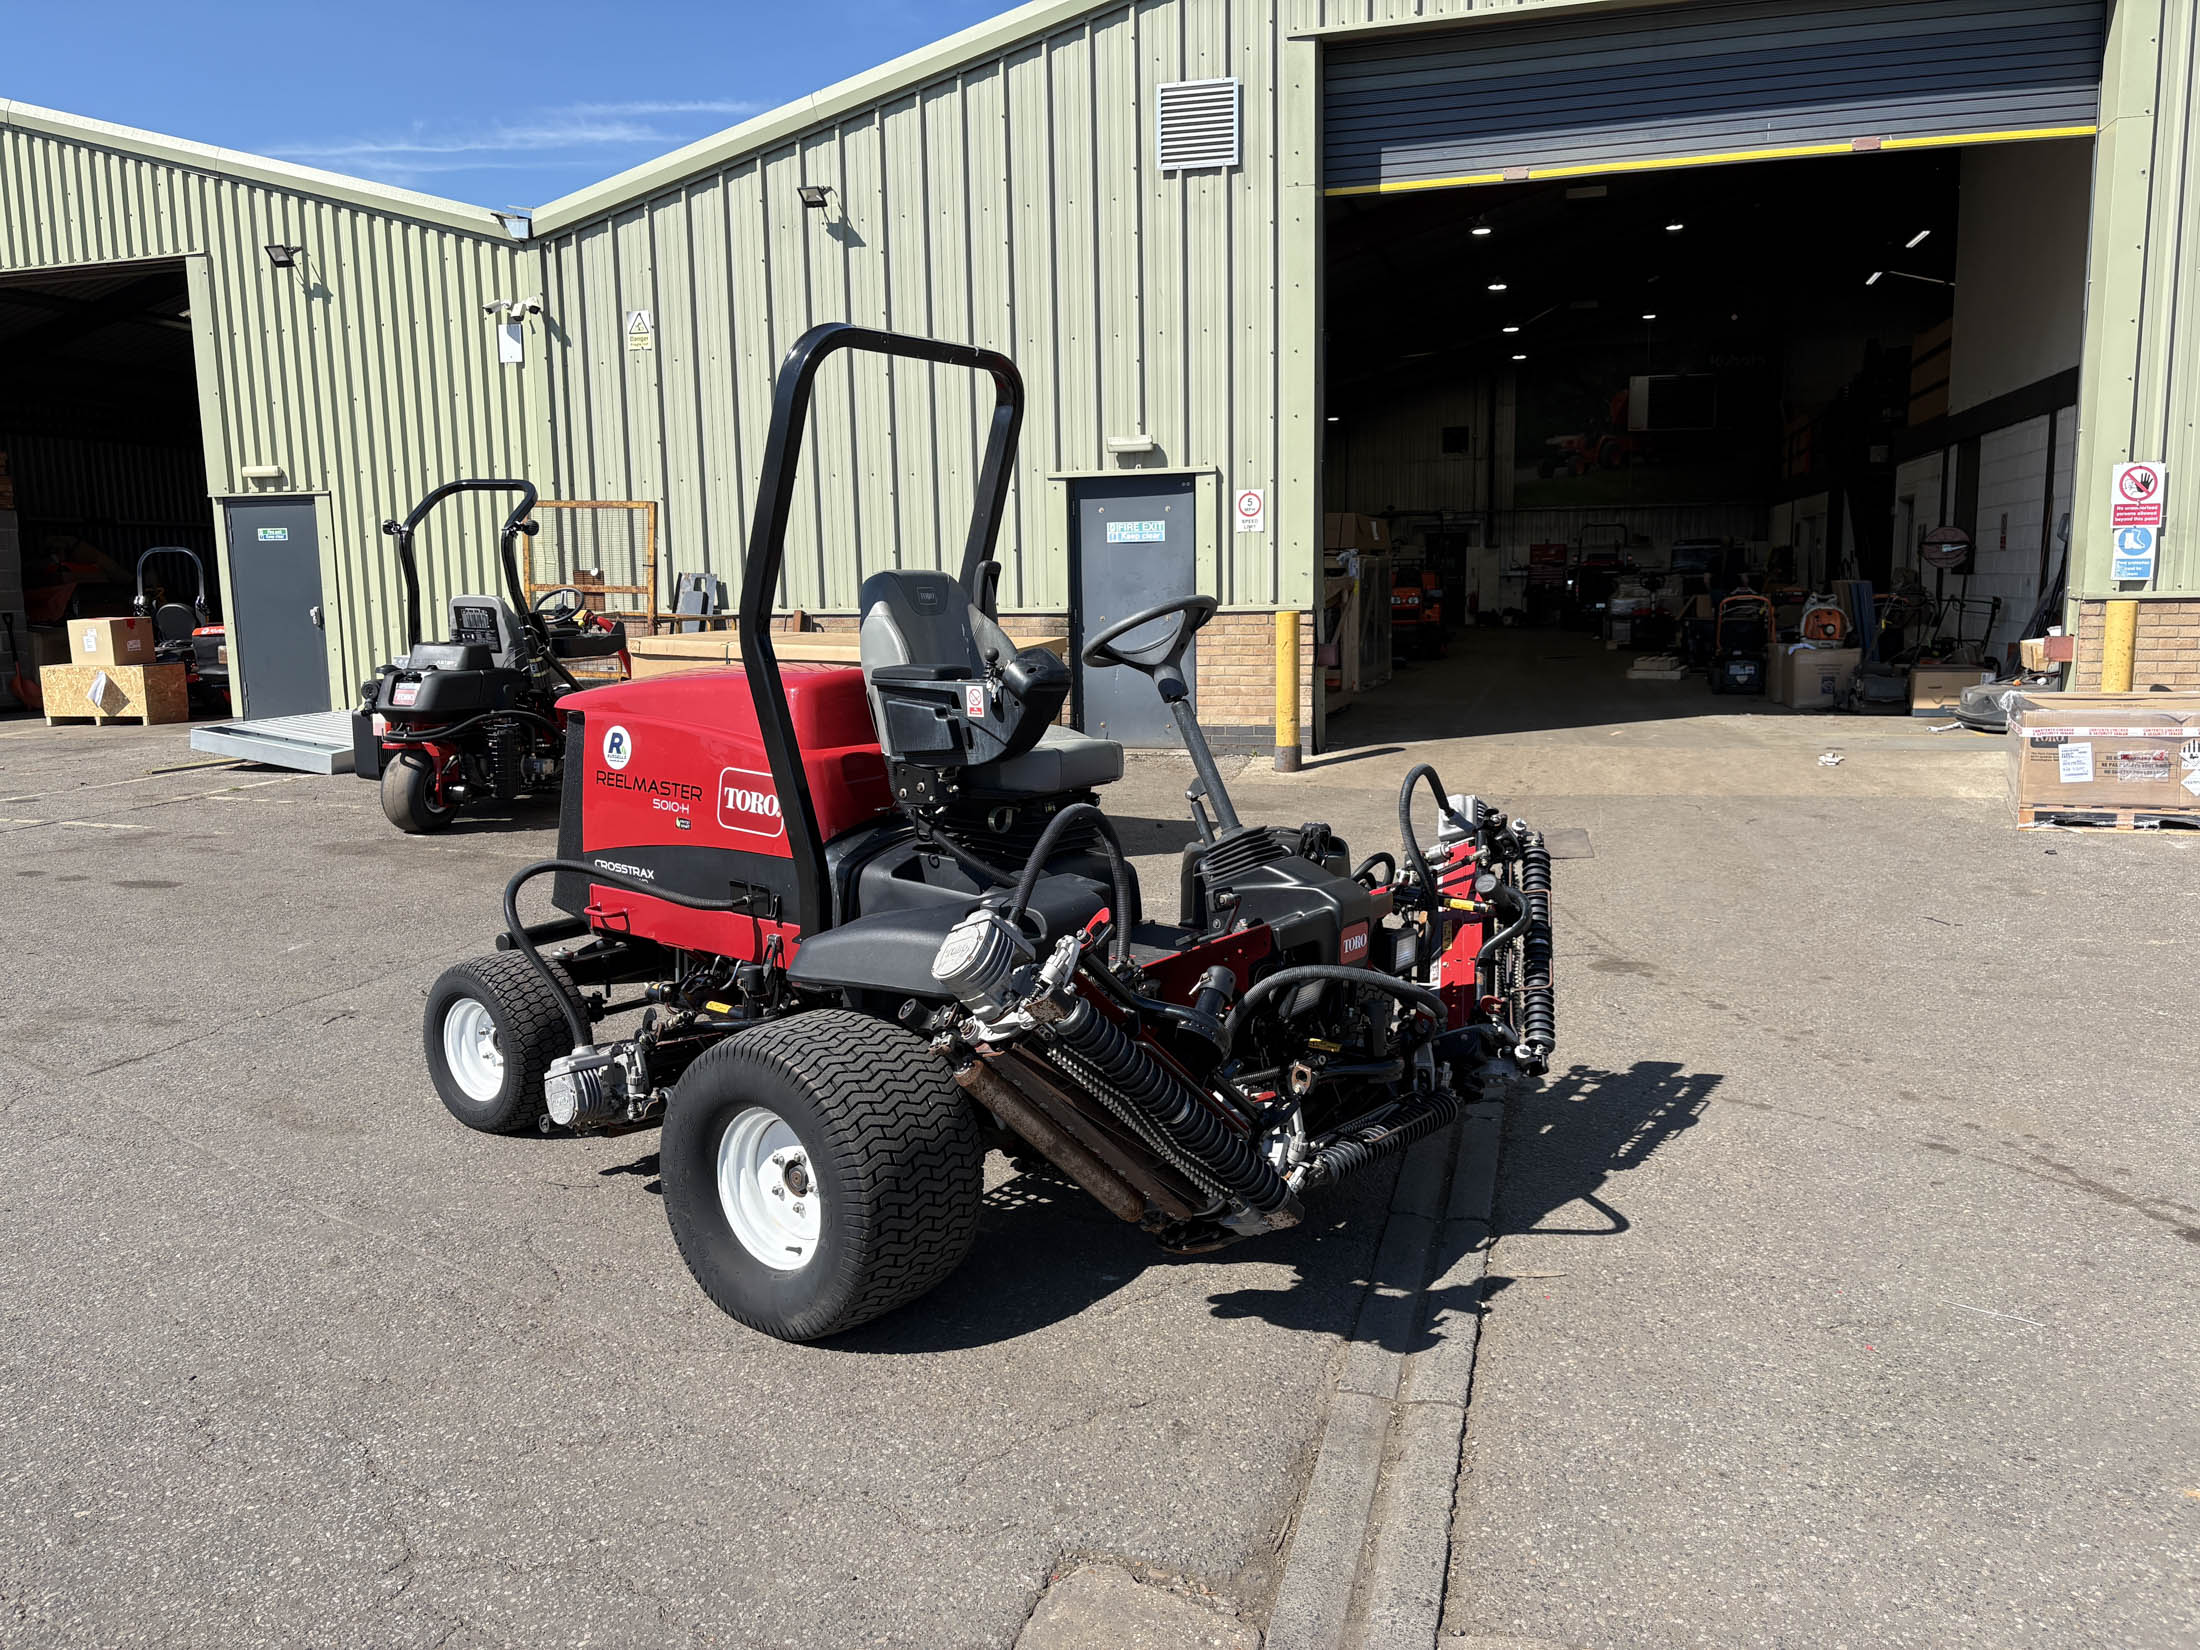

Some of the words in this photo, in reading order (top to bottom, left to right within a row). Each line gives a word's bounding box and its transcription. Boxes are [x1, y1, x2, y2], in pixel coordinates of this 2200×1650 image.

[1247, 498, 1253, 507] 5
[1119, 523, 1139, 531] FIRE
[1143, 522, 1161, 531] EXIT
[608, 732, 623, 754] R
[596, 770, 703, 802] REELMASTER
[724, 787, 779, 817] TORO
[594, 859, 655, 880] CROSSTRAX
[1343, 932, 1368, 953] TORO
